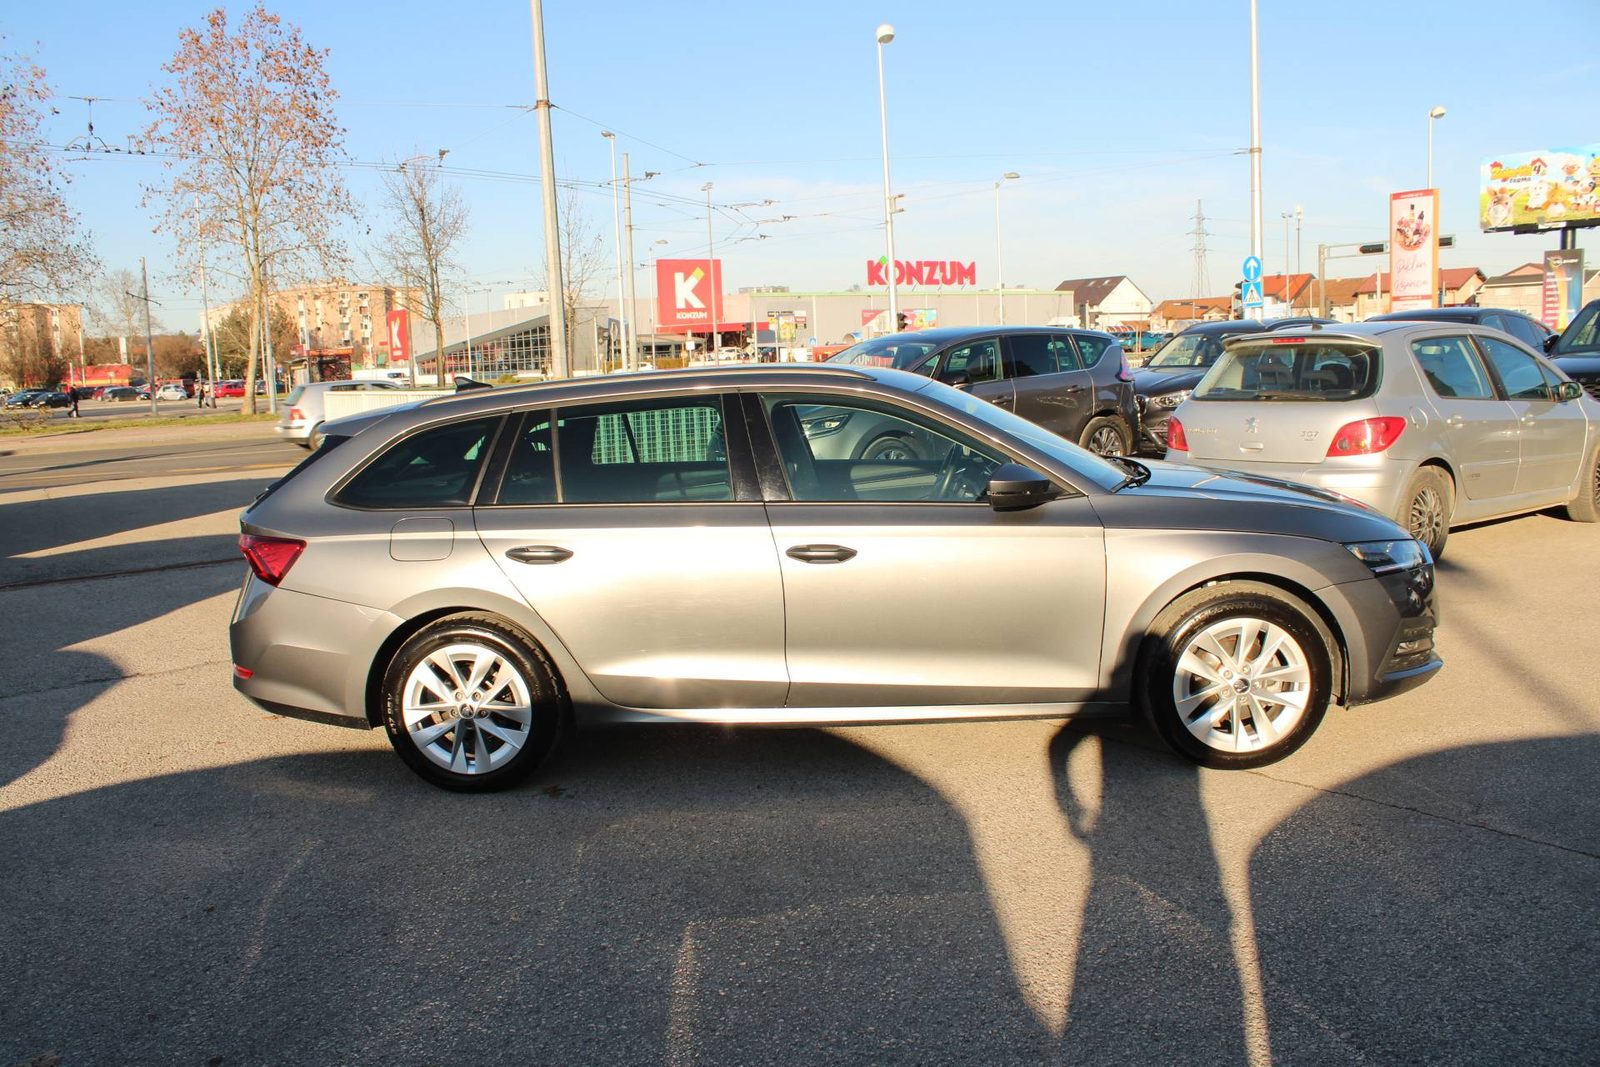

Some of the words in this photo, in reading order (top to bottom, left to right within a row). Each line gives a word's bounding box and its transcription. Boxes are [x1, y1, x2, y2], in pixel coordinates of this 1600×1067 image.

[867, 256, 976, 286] KONZUM
[674, 266, 707, 309] K
[676, 311, 707, 319] KONZUM
[391, 317, 402, 349] K
[1299, 430, 1320, 438] 307
